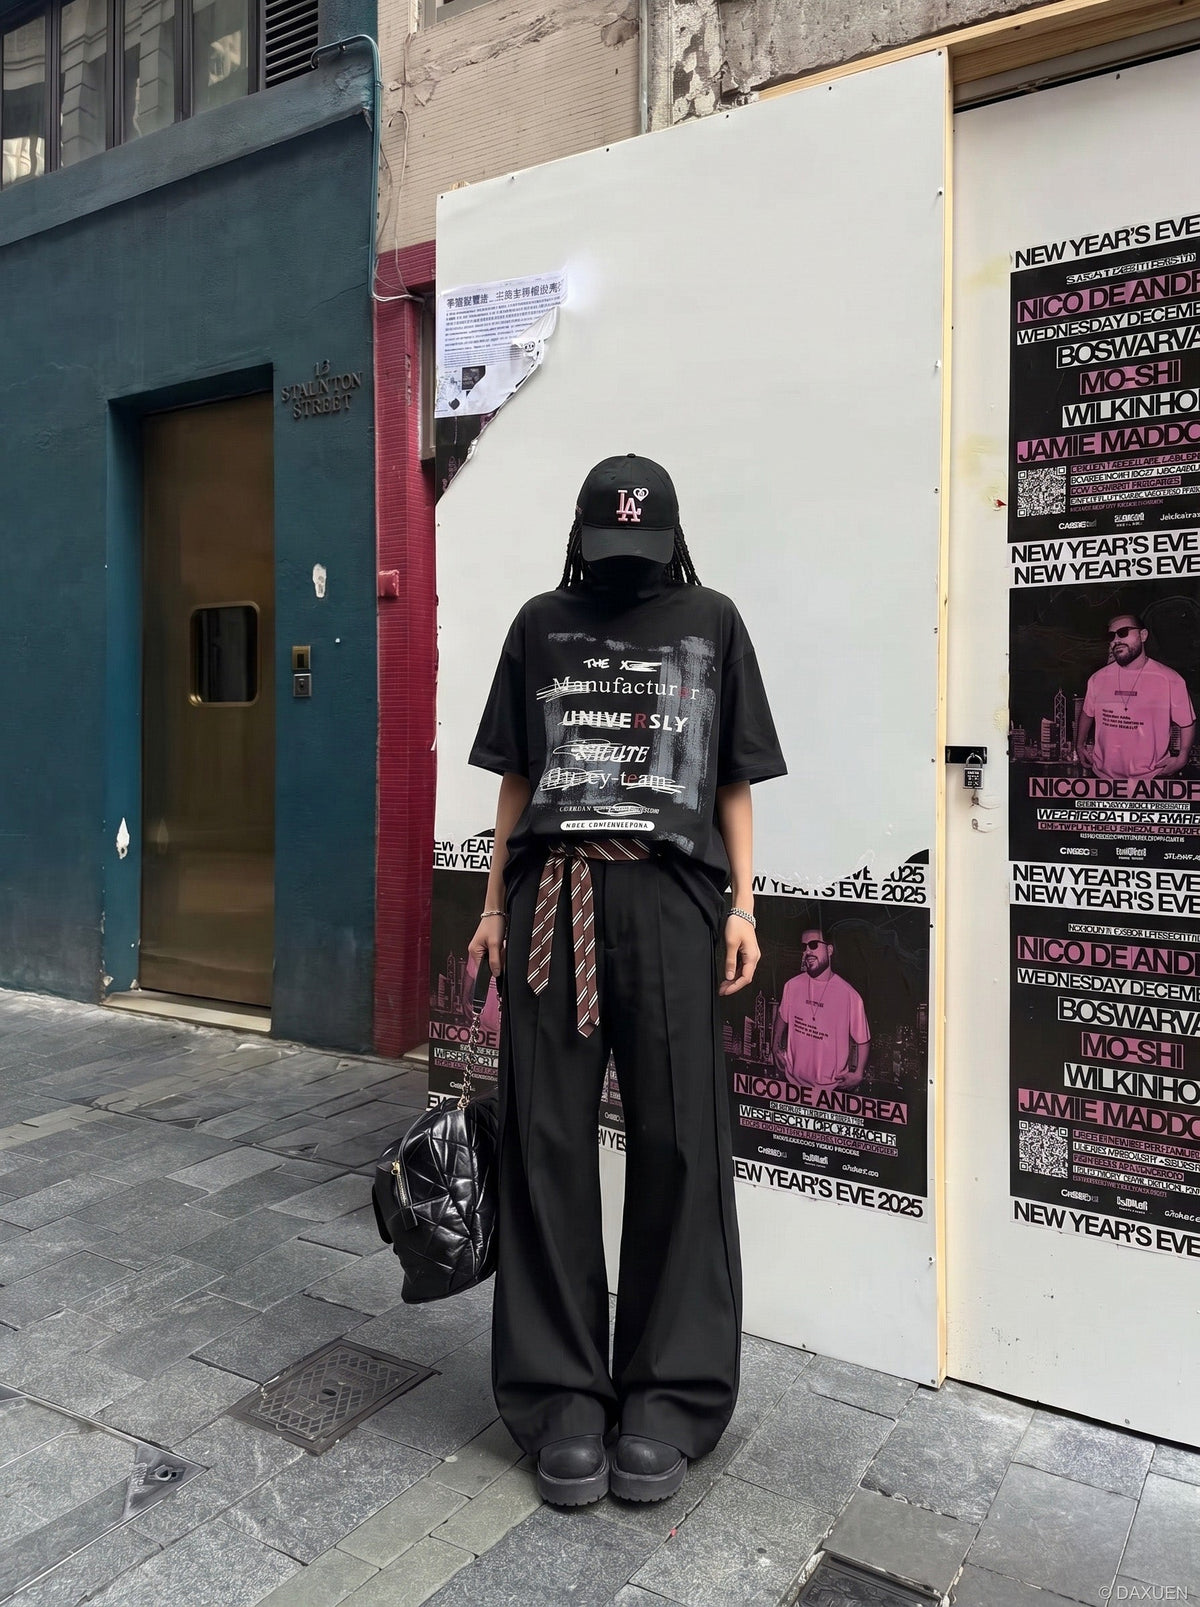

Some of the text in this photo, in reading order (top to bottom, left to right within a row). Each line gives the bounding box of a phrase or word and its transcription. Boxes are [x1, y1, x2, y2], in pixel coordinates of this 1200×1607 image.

[1015, 214, 1200, 268] NEW YEAR'S EVE
[1020, 292, 1083, 322] NICO
[1089, 284, 1126, 310] DE
[1018, 314, 1126, 344] WEDNESDAY
[1081, 361, 1180, 395] MO-SHI
[293, 393, 352, 418] STREET
[1064, 389, 1200, 426] WILKINHO
[1019, 434, 1095, 462] JAMIE
[616, 490, 642, 522] LA
[1012, 531, 1199, 564] NEW YEAR'S EVE
[1014, 554, 1200, 585] NEW YEAR'S EVE
[583, 658, 610, 669] THE
[562, 710, 688, 733] UNIVERSLY
[1032, 778, 1090, 798] NICO
[1095, 779, 1128, 798] DE
[433, 852, 492, 869] EW YEA
[840, 881, 878, 900] EVE
[881, 884, 926, 905] 2025
[1013, 864, 1200, 892] NEW YEAR'S EVE
[1015, 883, 1200, 914] NEW YEAR'S EVE
[1020, 936, 1200, 977] NICO DE AND
[1018, 968, 1127, 993] WEDNESDAY
[431, 1023, 471, 1042] NICO
[1082, 1032, 1183, 1069] MO-SHI
[736, 1074, 781, 1099] NICO
[786, 1083, 812, 1105] DE
[816, 1089, 906, 1124] ANDREA
[1066, 1063, 1200, 1104] WILKINHO
[1020, 1091, 1097, 1123] JAMIE
[765, 1167, 833, 1198] YEAR'S
[837, 1182, 875, 1208] EVE
[878, 1192, 924, 1218] 2025
[1014, 1200, 1066, 1229] NEW
[1069, 1211, 1152, 1247] YEAR'S
[1156, 1229, 1200, 1257] EVE
